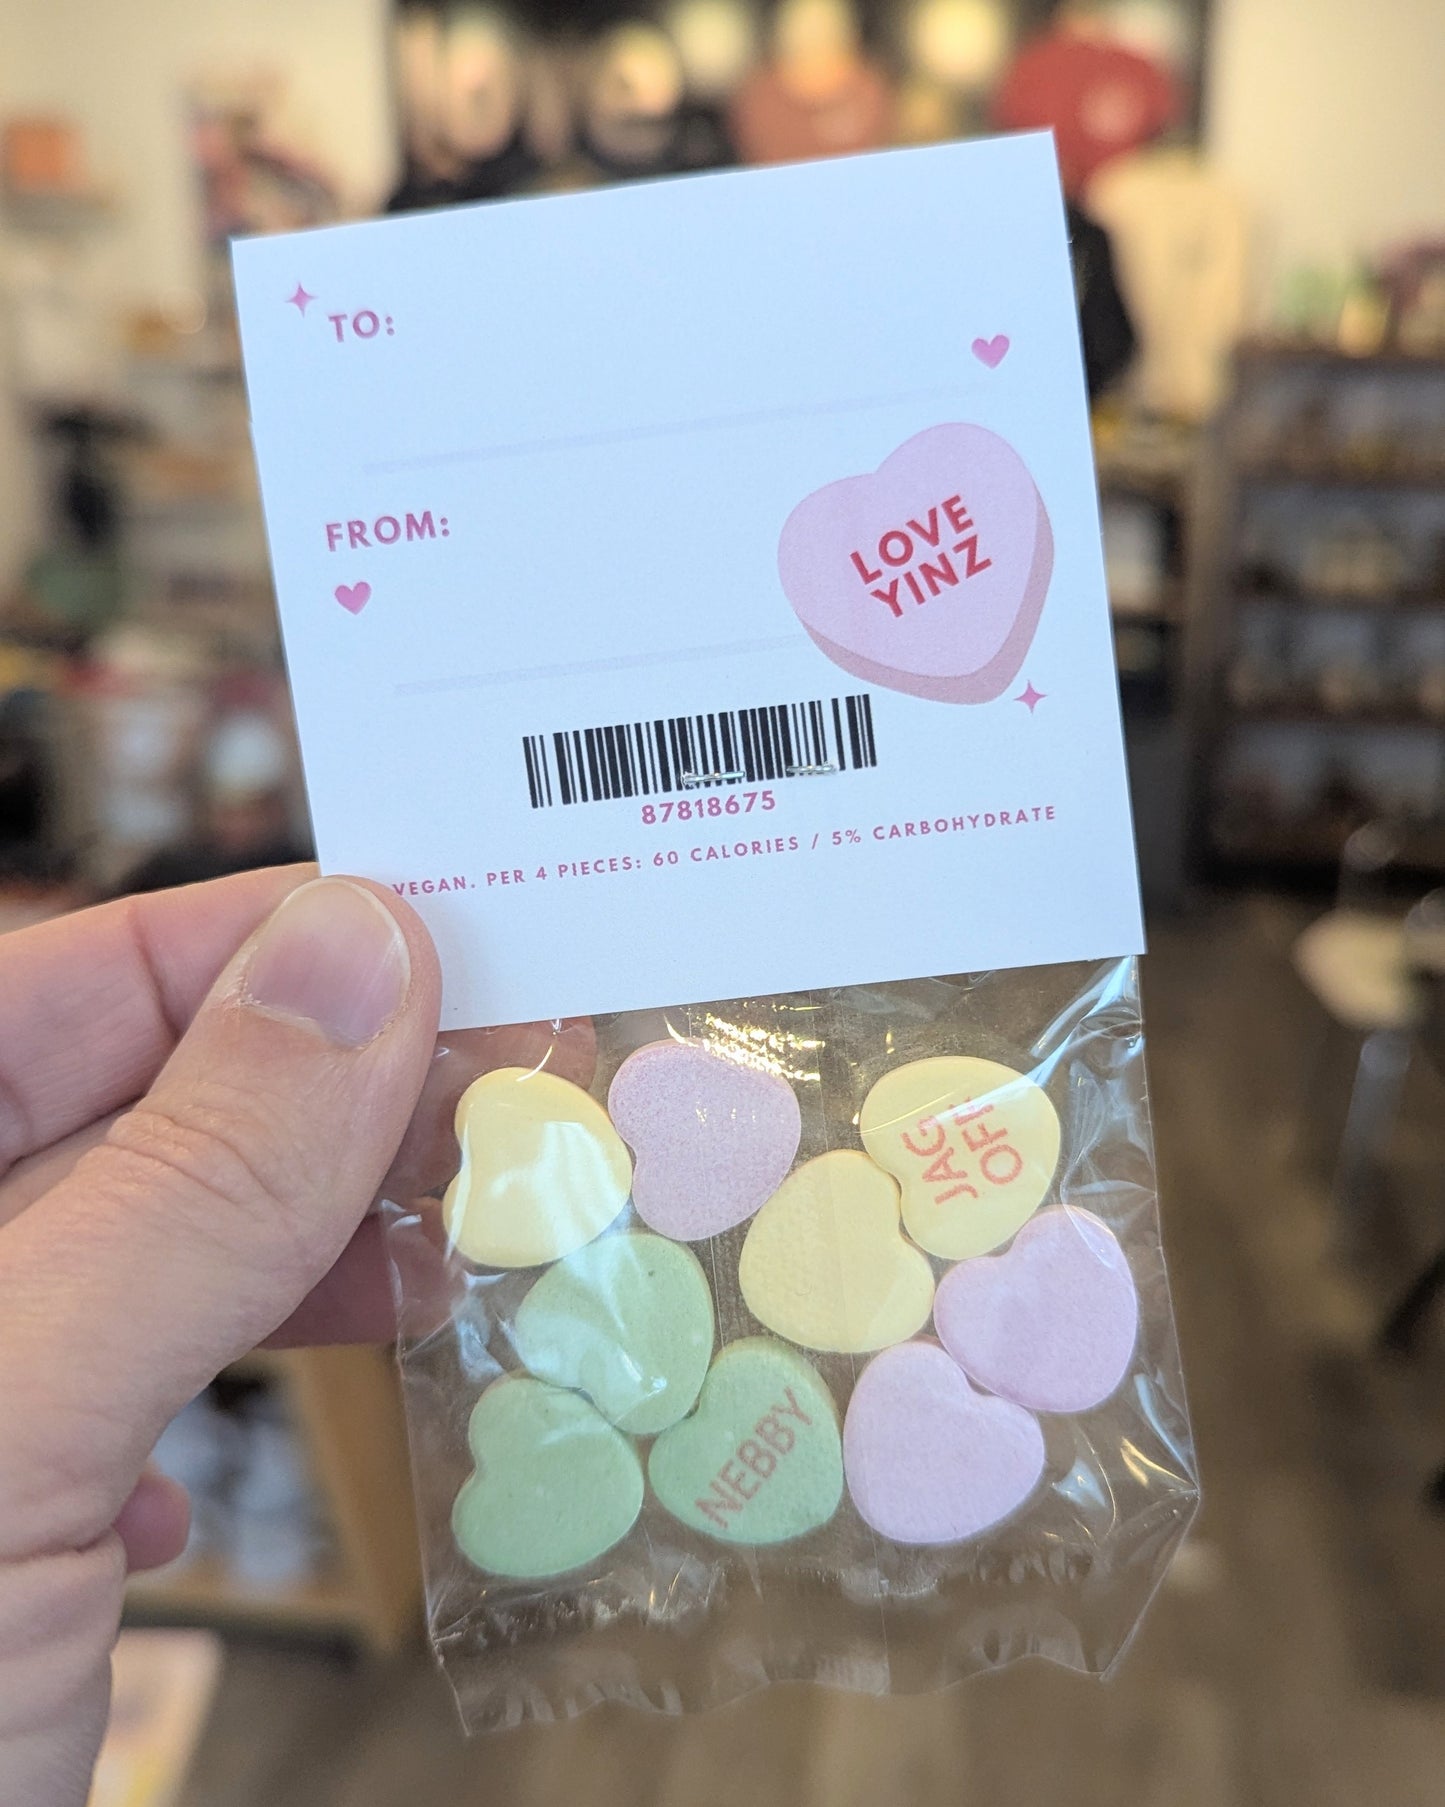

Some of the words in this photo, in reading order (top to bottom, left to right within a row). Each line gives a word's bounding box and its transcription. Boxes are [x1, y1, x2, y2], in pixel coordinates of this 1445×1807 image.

[328, 310, 395, 343] TO:
[325, 510, 450, 552] FROM:
[849, 494, 974, 585] LOVE
[870, 534, 993, 618] YINZ
[392, 875, 476, 896] VEGAN.
[486, 869, 526, 886] PER
[535, 866, 548, 881] 4
[557, 856, 642, 879] PIECES:
[652, 850, 679, 867] 60
[690, 836, 799, 862] CALORIES
[811, 833, 819, 849] /
[831, 829, 861, 846] 5%
[872, 806, 1056, 841] CARBOHYDRATE
[641, 790, 776, 825] 87818675
[901, 1115, 979, 1205] JAG
[694, 1386, 813, 1529] NEBBY
